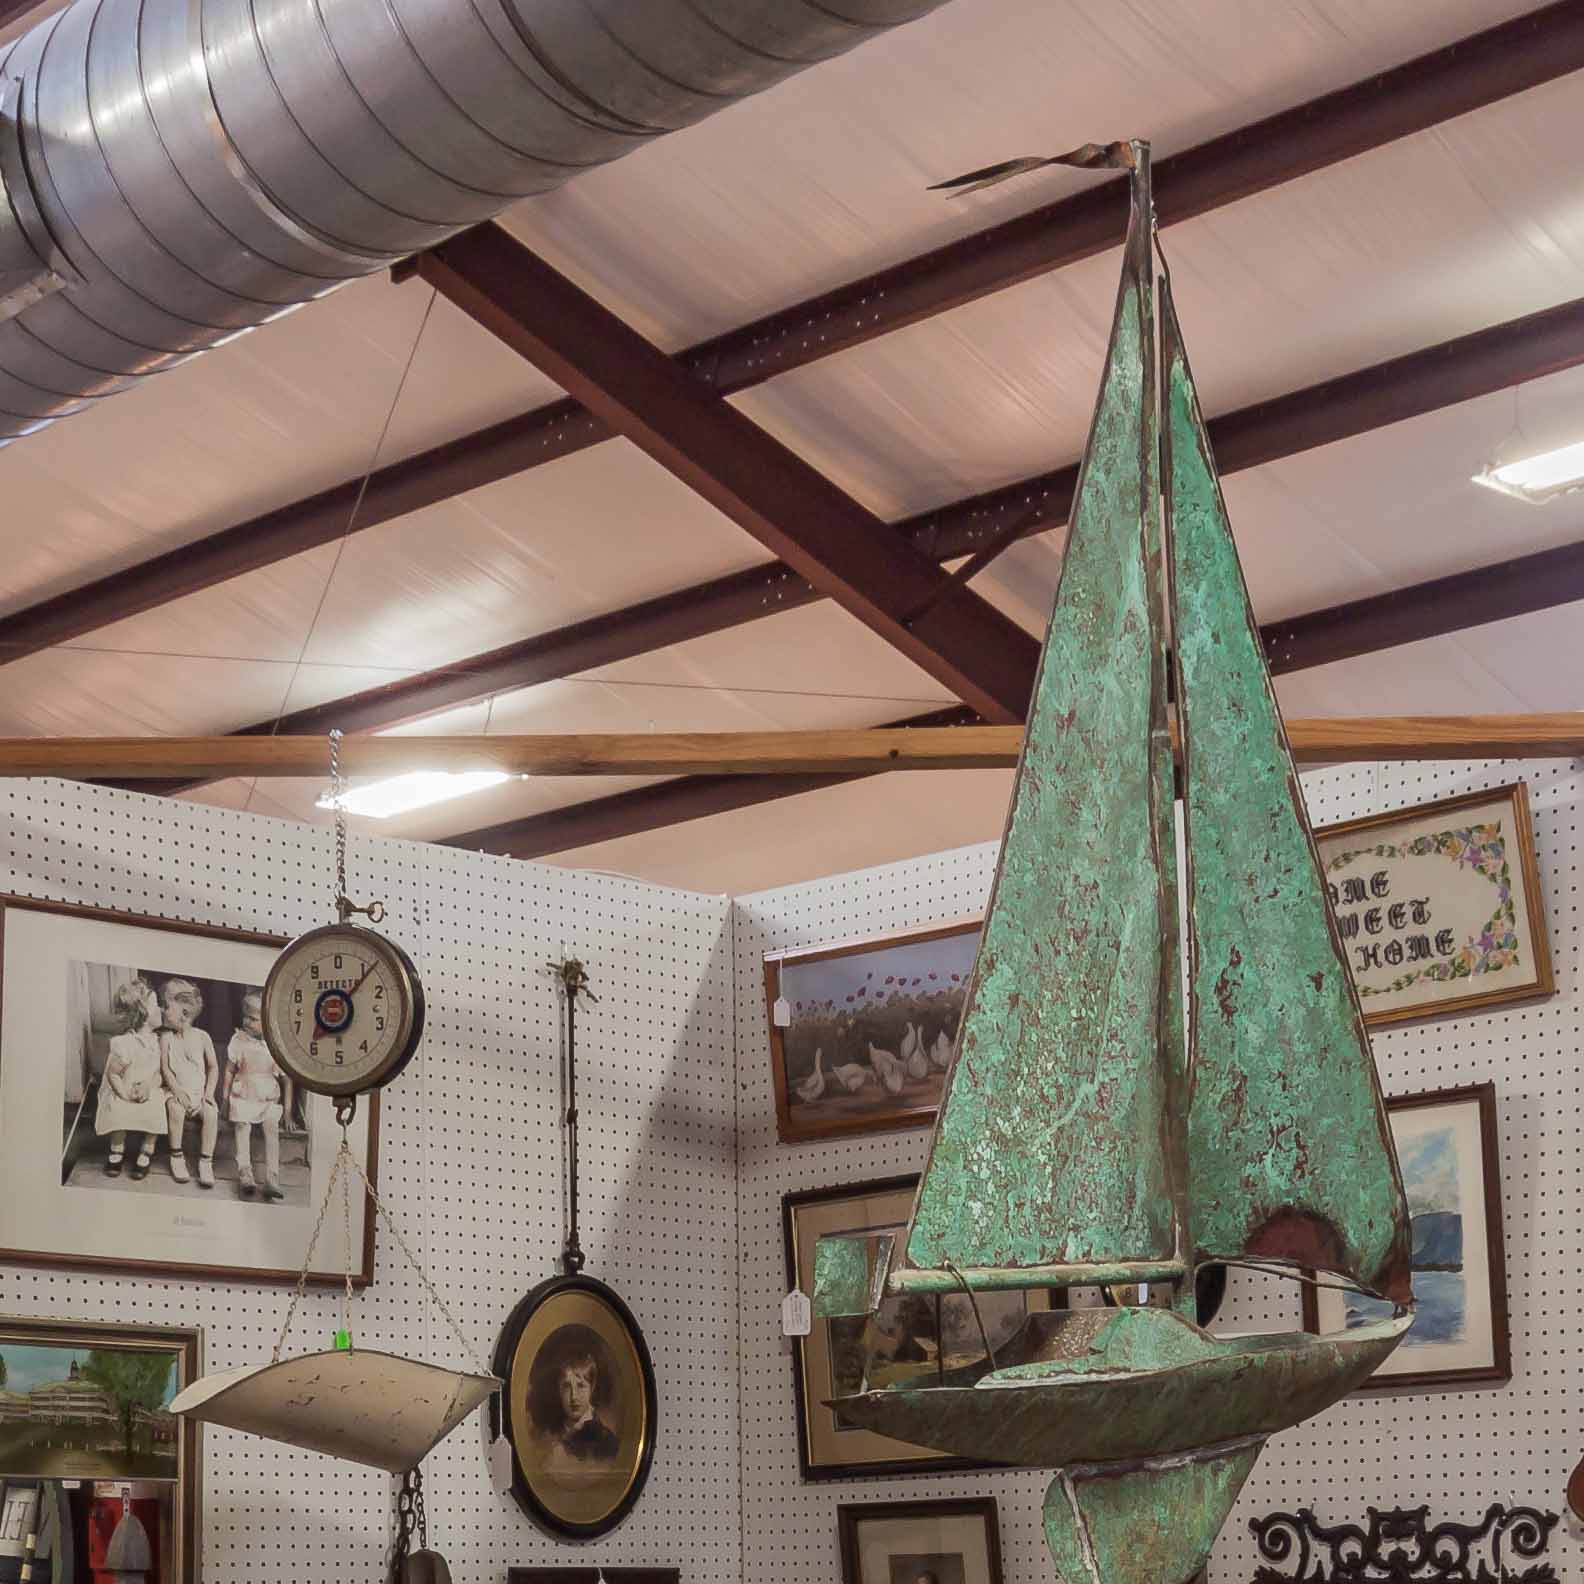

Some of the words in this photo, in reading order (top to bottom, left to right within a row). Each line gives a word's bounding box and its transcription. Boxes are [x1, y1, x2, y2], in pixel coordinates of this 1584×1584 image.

[1336, 896, 1431, 940] WEET
[1354, 927, 1456, 973] HOME
[334, 955, 343, 969] 0
[310, 965, 319, 979] 9
[294, 989, 302, 1003] 8
[374, 985, 383, 999] 2
[294, 1021, 302, 1034] 7
[375, 1016, 384, 1030] 3
[309, 1042, 318, 1055] 6
[359, 1039, 368, 1053] 4
[335, 1050, 343, 1064] 5
